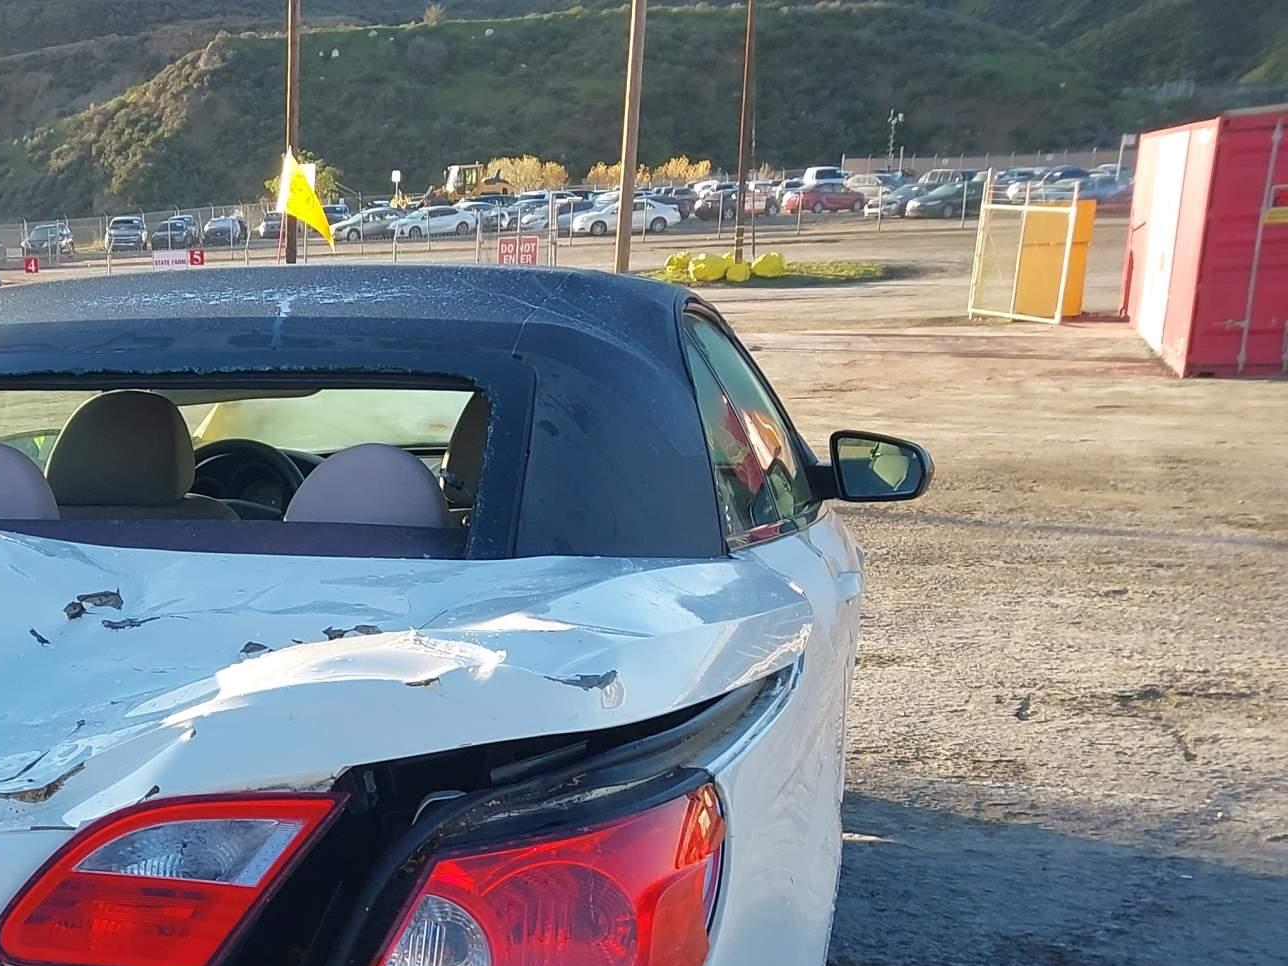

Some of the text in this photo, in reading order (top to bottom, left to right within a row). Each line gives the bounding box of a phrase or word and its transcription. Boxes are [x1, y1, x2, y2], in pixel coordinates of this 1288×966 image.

[500, 243, 514, 254] DO
[192, 250, 201, 264] 5
[503, 254, 532, 264] ENER
[28, 258, 36, 272] 4
